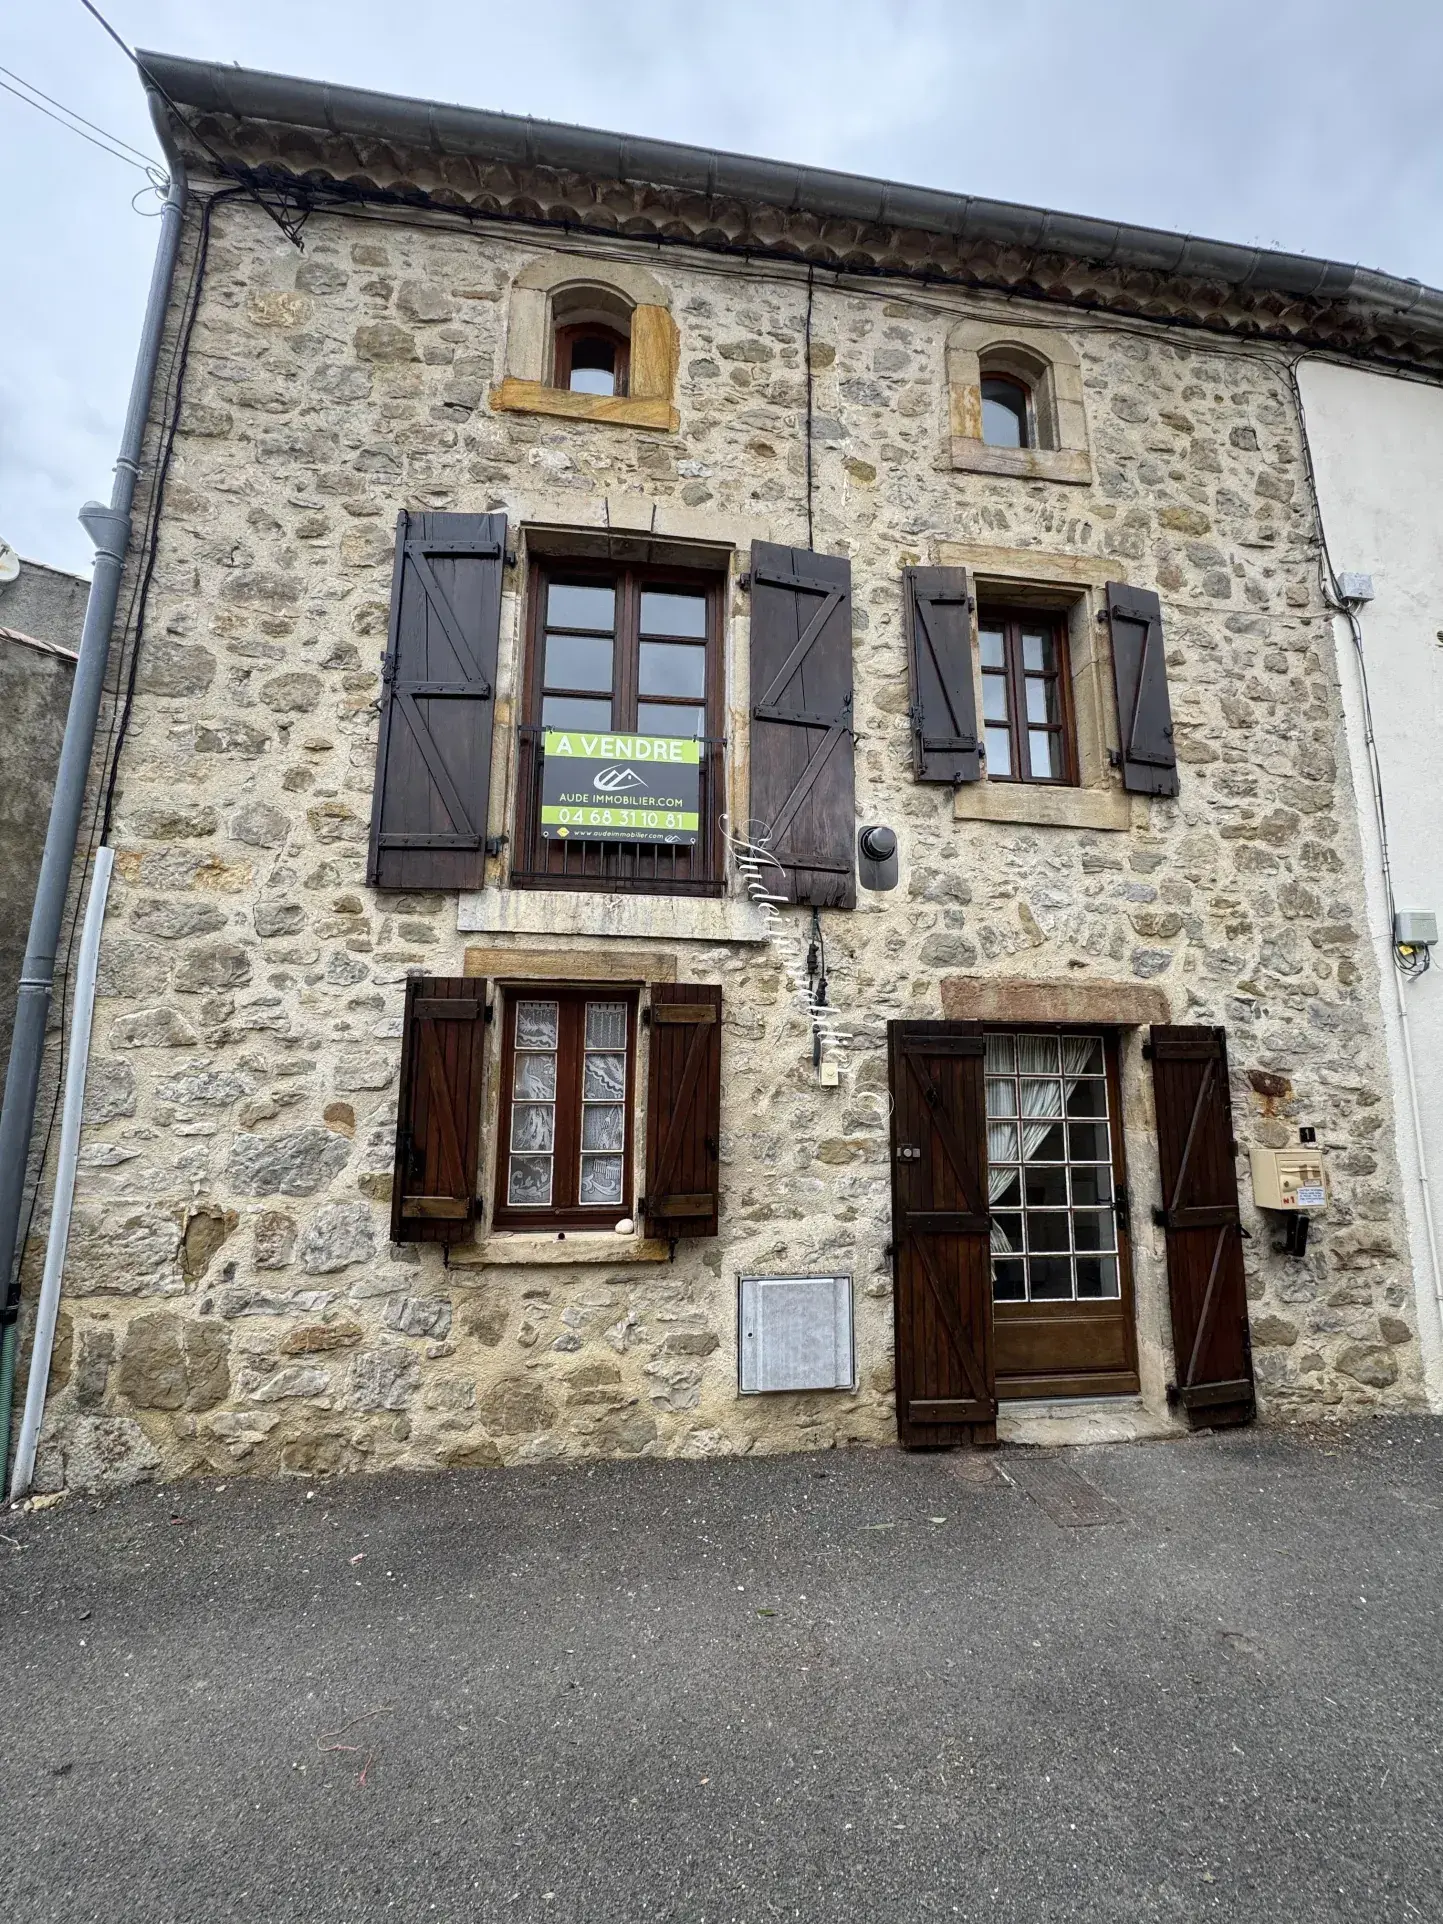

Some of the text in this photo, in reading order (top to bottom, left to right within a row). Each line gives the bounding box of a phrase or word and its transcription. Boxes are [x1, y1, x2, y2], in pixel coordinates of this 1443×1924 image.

[556, 735, 683, 761] A VENDRE
[559, 793, 683, 807] AUDE IMMOBILIER.COM
[559, 808, 683, 828] 04 68 31 10 81
[1304, 1128, 1310, 1140] 1
